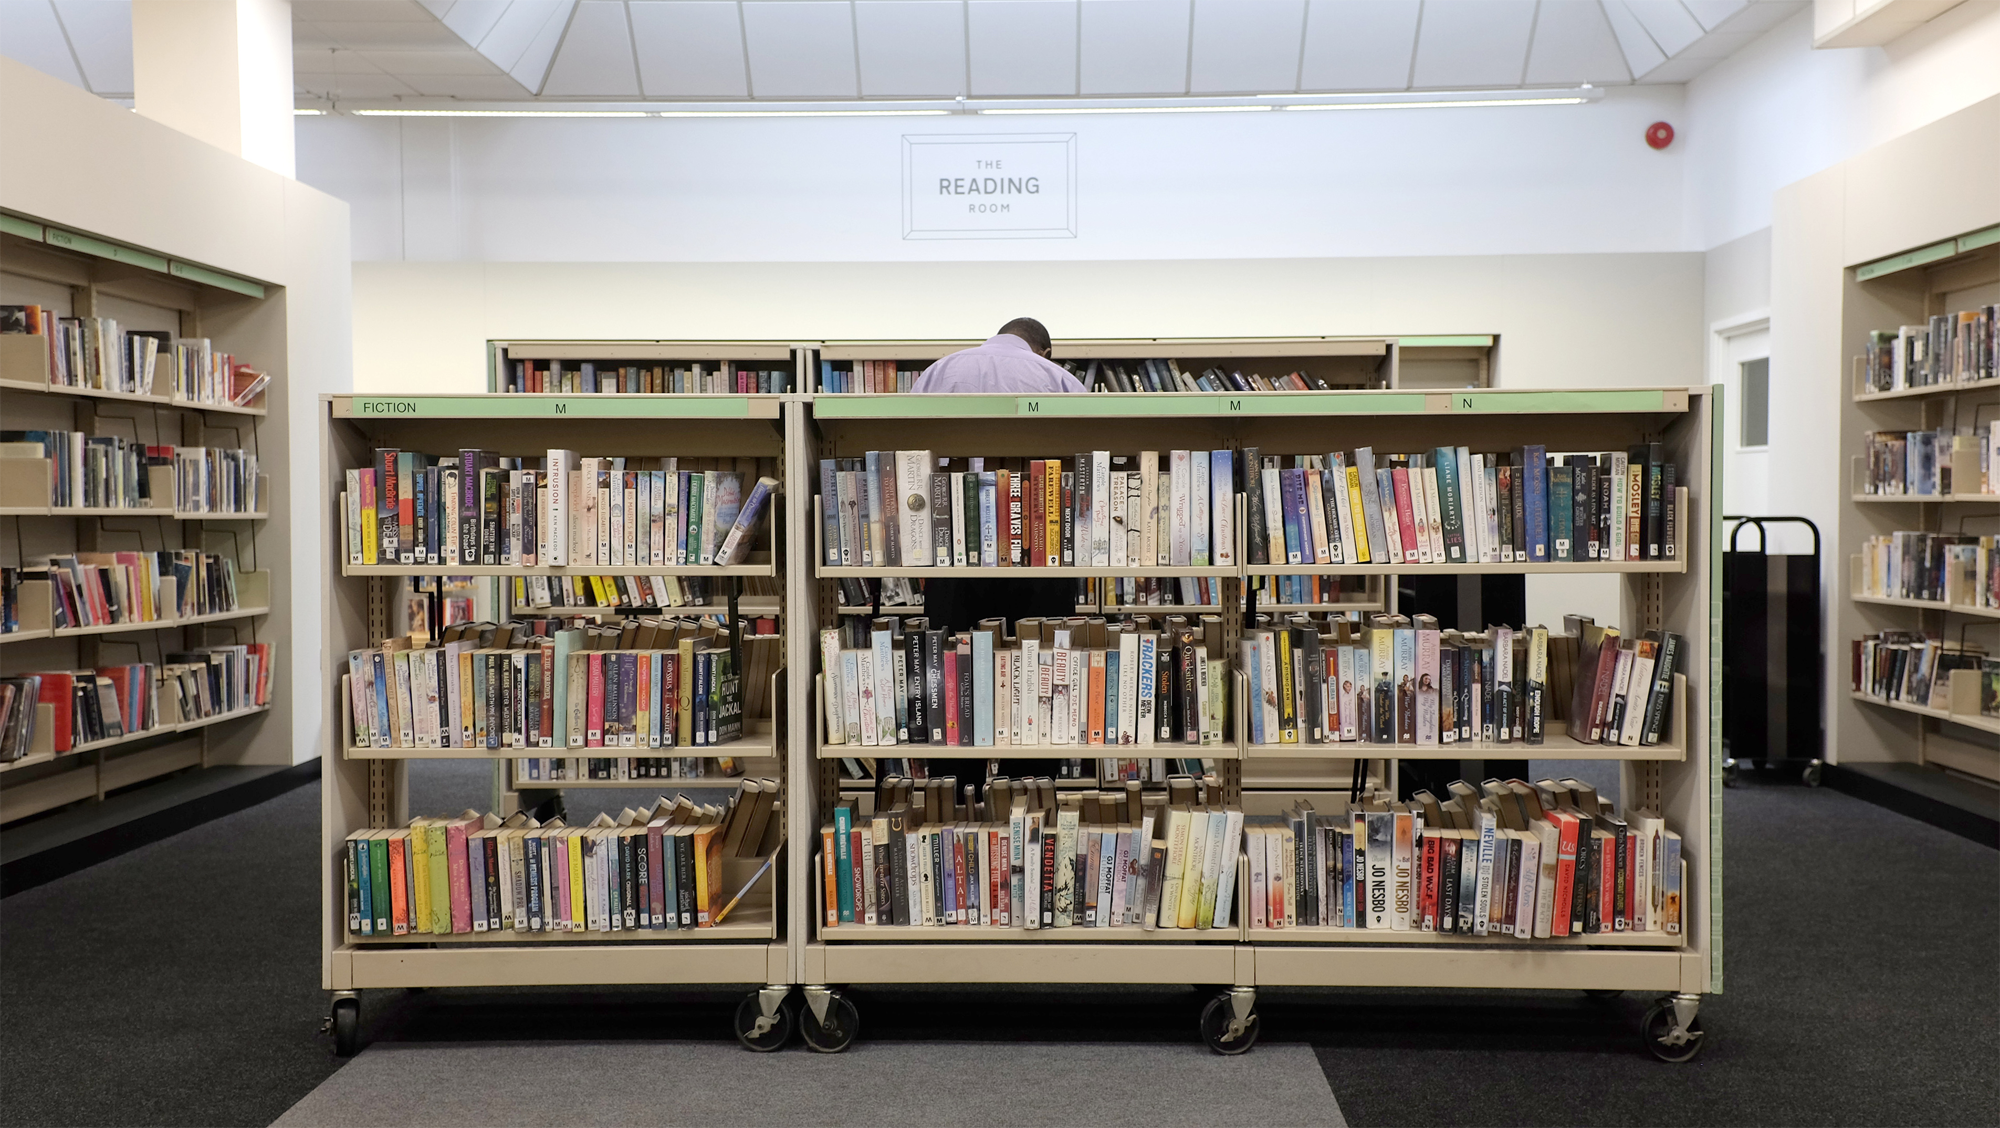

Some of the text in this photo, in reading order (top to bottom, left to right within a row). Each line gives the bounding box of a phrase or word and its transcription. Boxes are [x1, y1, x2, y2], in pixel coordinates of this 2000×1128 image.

[976, 160, 1002, 170] THE
[939, 176, 1040, 195] READING
[969, 203, 1011, 213] ROOM
[363, 402, 567, 414] FICTION M
[1028, 401, 1040, 412] M
[1230, 400, 1241, 411] M
[1462, 398, 1473, 410] N
[384, 453, 397, 510] Stuart MacBride
[465, 453, 473, 508] STUART MACBRIDE
[906, 454, 916, 491] MARTIN
[1650, 466, 1661, 500] MOSLEY
[934, 476, 943, 508] MARTIN
[1010, 472, 1022, 535] THREE GRAVES
[1444, 462, 1456, 525] LIANE MORIARTY
[1616, 495, 1623, 505] TO
[1631, 473, 1640, 516] MOSLEY
[1176, 494, 1186, 527] Wrapped
[1666, 504, 1675, 521] BLACK
[469, 518, 477, 546] Birthdays
[1056, 651, 1067, 683] BEAUTY
[1378, 636, 1386, 670] MURRAY
[1422, 633, 1431, 672] MURRAY
[1501, 632, 1510, 681] BARBARA NADEL
[1535, 632, 1544, 680] BARBARA NADEL
[1661, 637, 1677, 681] JAMES NAUGHTIE
[1013, 655, 1021, 706] BLACK LIGHT
[1025, 643, 1035, 695] Almost English
[1040, 667, 1049, 696] BEAUTY
[1122, 679, 1128, 691] NO
[1141, 639, 1154, 699] TRACKERS
[1161, 670, 1170, 695] Stolen
[1183, 645, 1194, 693] Quicksilver
[1598, 670, 1610, 696] NADEL
[914, 676, 922, 699] ENTRY
[930, 668, 939, 709] CHESSMEN
[1484, 681, 1492, 702] NADEL
[1533, 690, 1541, 716] ENOUGH
[915, 700, 923, 726] ISLAND
[1595, 701, 1604, 725] DEADLINE
[1651, 693, 1665, 733] PARIS SPRING
[680, 843, 686, 853] WE
[1012, 821, 1022, 862] DENISE MINA
[1171, 824, 1181, 865] MONTEFIORE
[1179, 824, 1187, 845] SIMON
[1209, 819, 1222, 879] Santa Montefiore
[1427, 839, 1435, 855] BIG
[1617, 827, 1625, 868] Chris Nickson
[1638, 839, 1646, 858] BROKEN
[638, 847, 648, 885] SCORE
[909, 842, 919, 887] snowdrops
[933, 838, 941, 864] MILLER
[1043, 838, 1055, 892] VENDETTA
[1089, 842, 1099, 871] Emma
[1106, 855, 1113, 865] GJ
[1121, 850, 1129, 883] GJ MOFFAT
[1579, 847, 1587, 870] ORCS
[514, 870, 523, 896] SHADOW
[956, 855, 964, 905] ALTAI
[1357, 854, 1365, 881] JO NESBO
[1479, 827, 1495, 919] NEVILLE STOLEN SOULS
[854, 867, 863, 912] SNOWDROPS
[1371, 864, 1386, 913] JO NESBO
[1395, 864, 1410, 914] JO NESBO
[1425, 876, 1434, 900] WOLF
[1560, 886, 1568, 918] NICHOLLS
[1444, 898, 1452, 918] DAYS
[1462, 902, 1472, 913] 16
